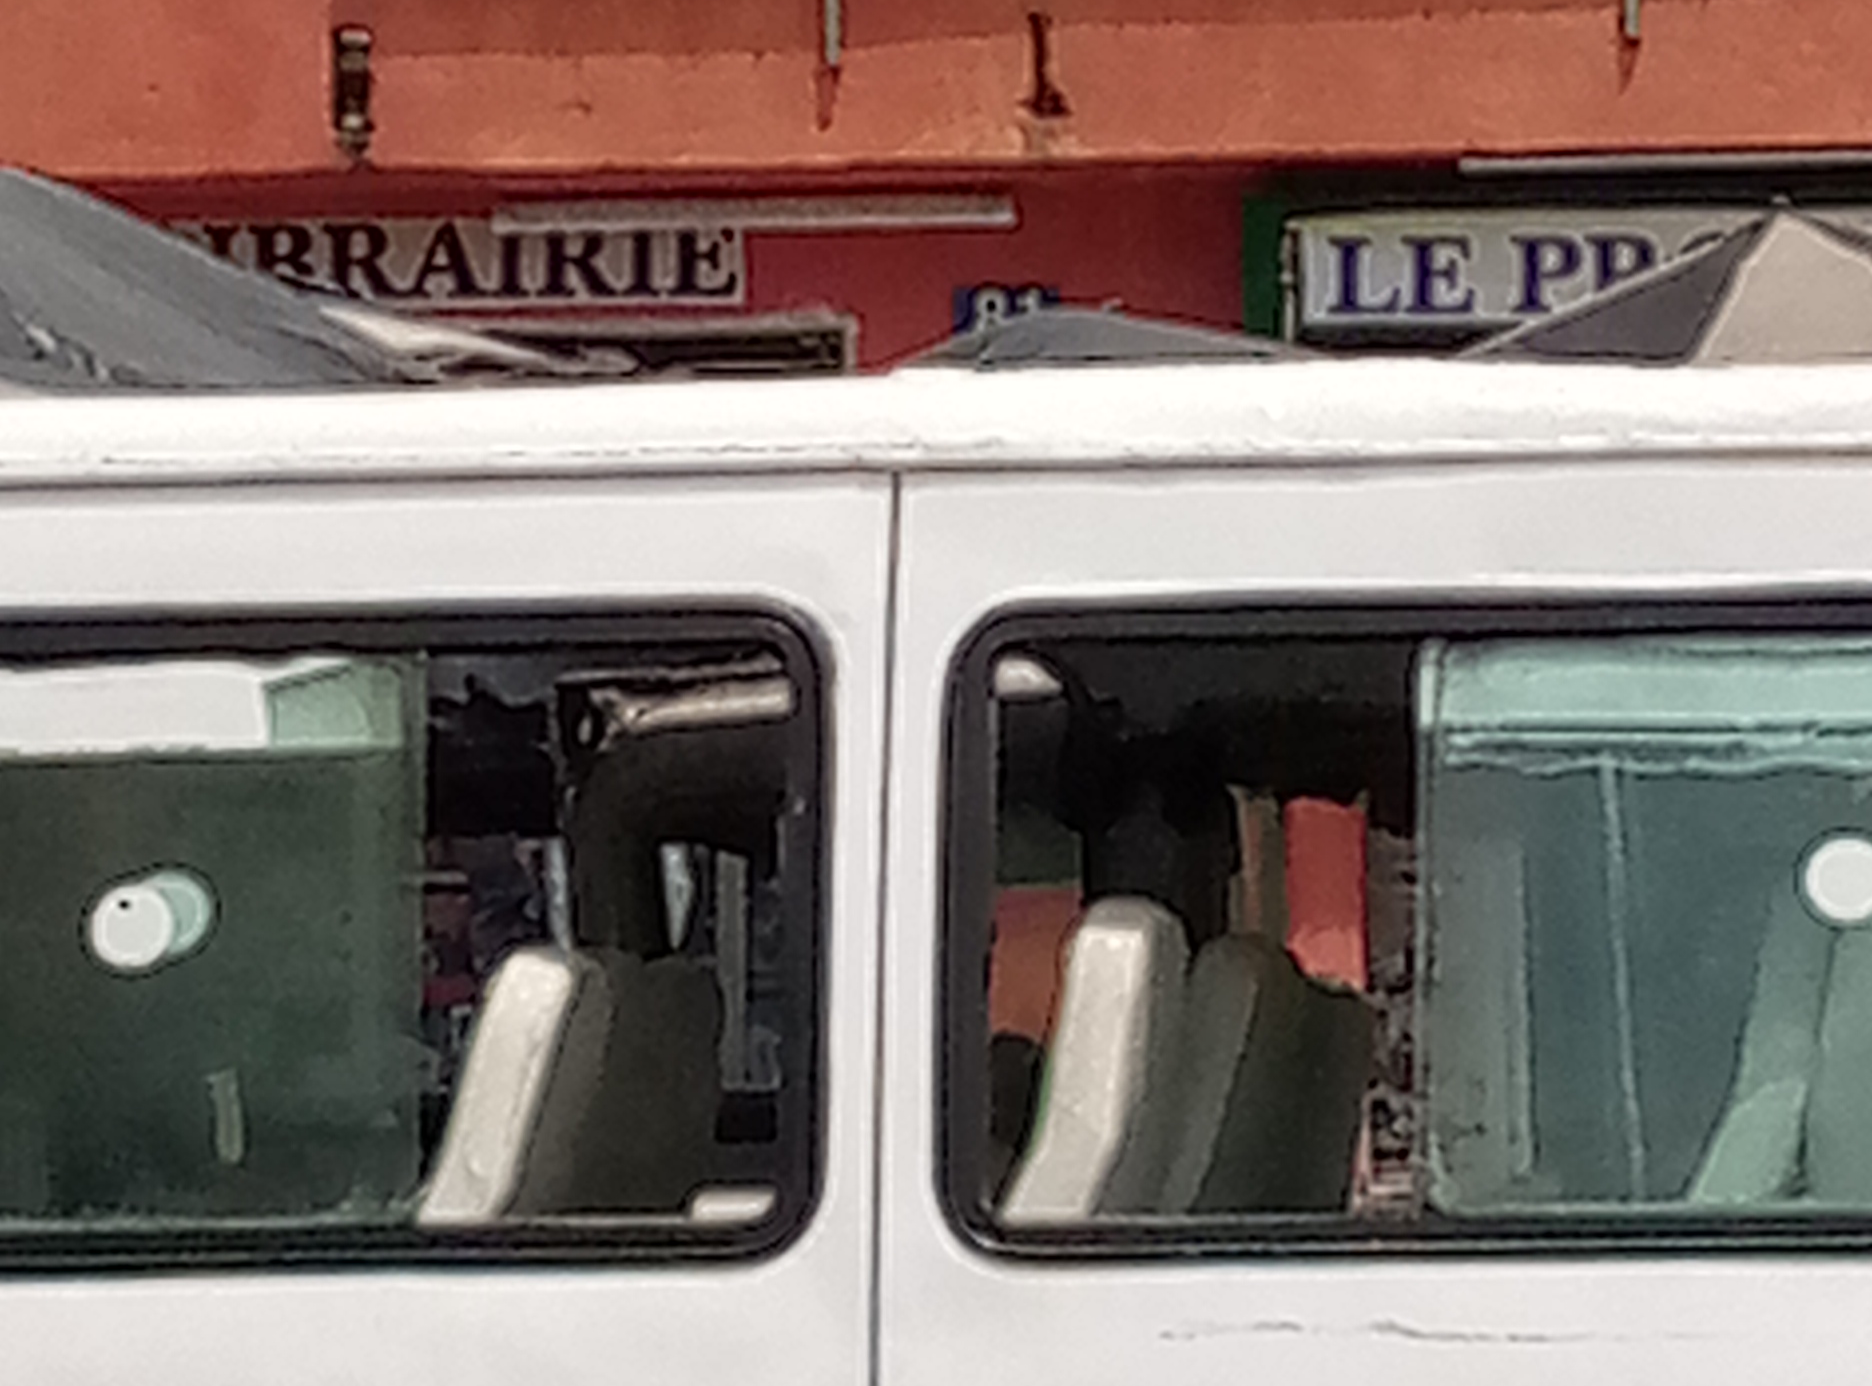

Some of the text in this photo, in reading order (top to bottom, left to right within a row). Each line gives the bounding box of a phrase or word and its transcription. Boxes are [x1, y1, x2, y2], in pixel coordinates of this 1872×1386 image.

[203, 218, 740, 301] IBRAIRIE
[1327, 231, 1726, 315] LE PR
